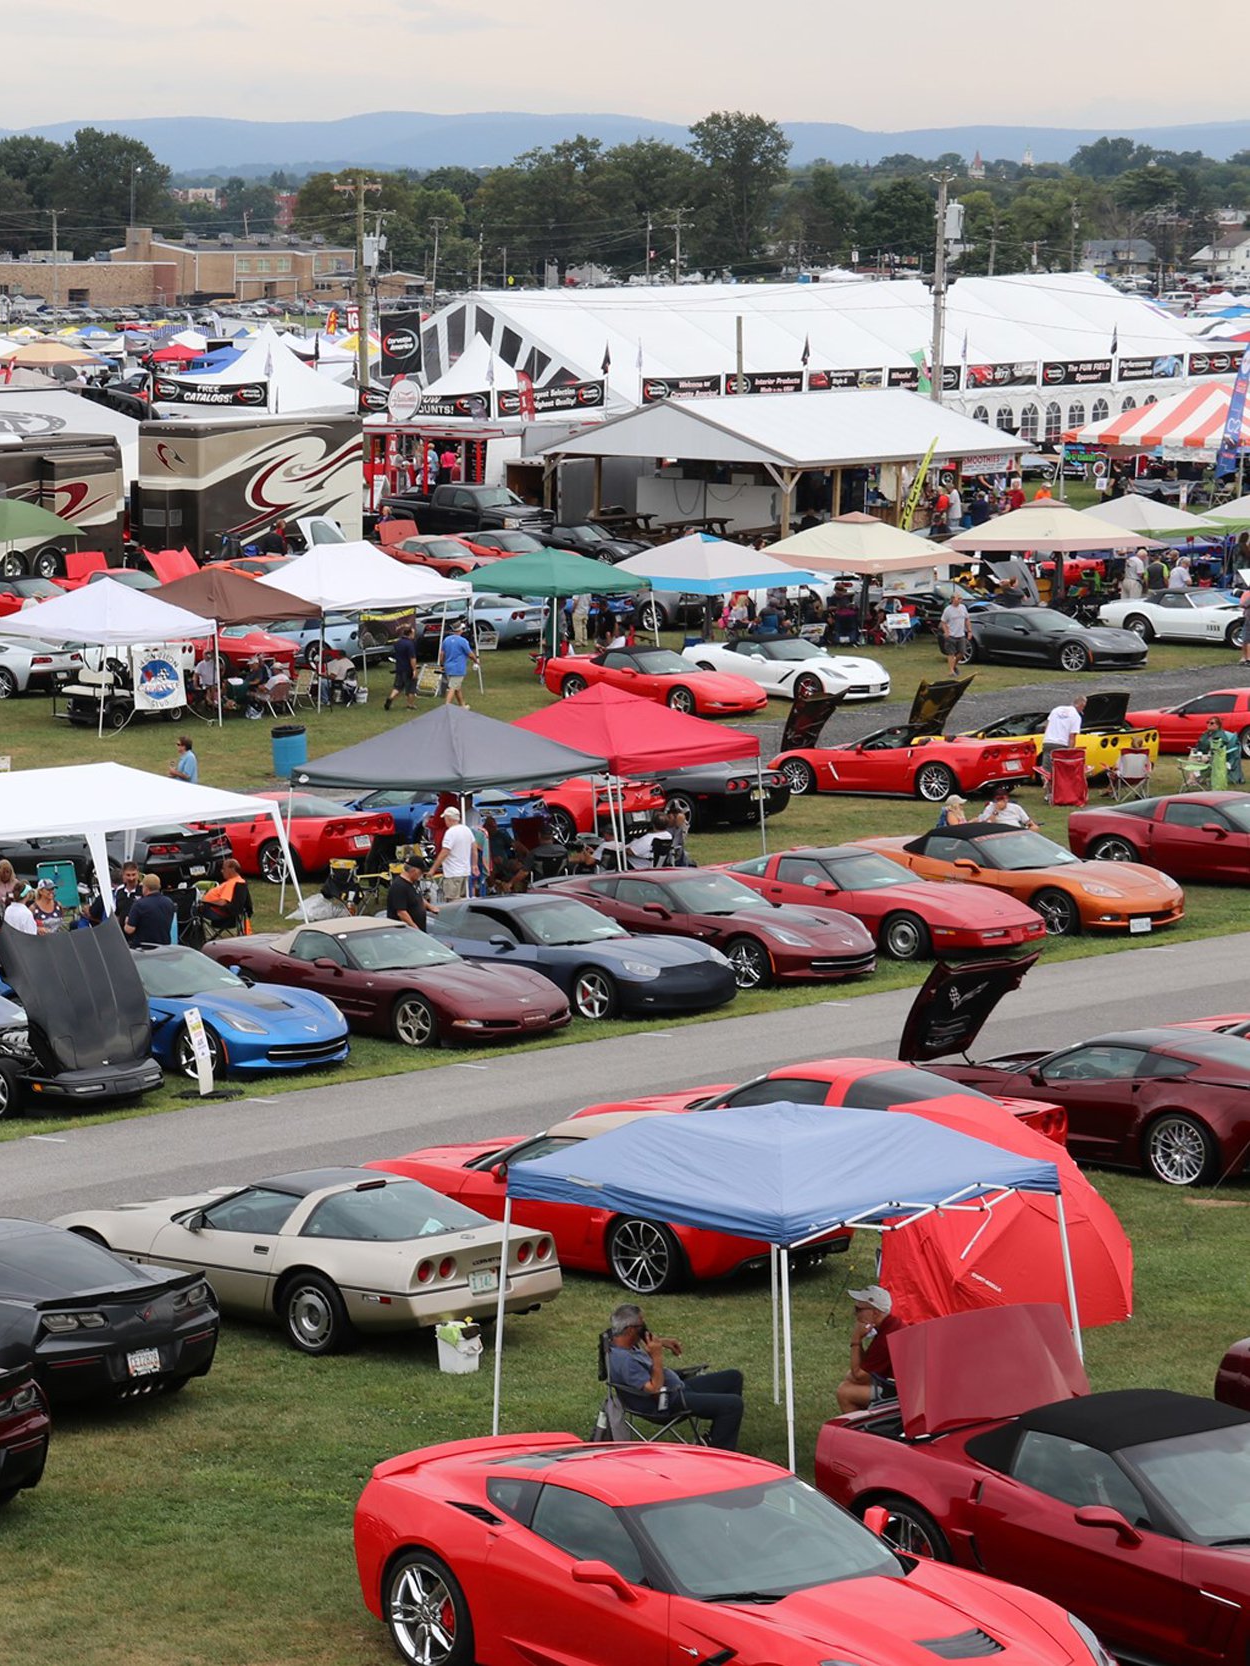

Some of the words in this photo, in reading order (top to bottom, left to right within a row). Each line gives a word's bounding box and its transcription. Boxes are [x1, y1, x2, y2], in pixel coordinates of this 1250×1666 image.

[387, 336, 412, 344] Corvette
[389, 343, 414, 351] America
[1067, 364, 1078, 372] The
[1078, 363, 1092, 372] FUN
[1092, 362, 1111, 371] FIELD
[755, 377, 776, 386] Interior
[776, 376, 801, 385] Products
[1075, 372, 1102, 382] Sponsor!
[196, 385, 221, 393] FREE
[549, 388, 576, 397] Selection
[183, 392, 232, 403] CATALOGS!
[669, 391, 694, 399] Corvette
[534, 398, 555, 409] ighest
[555, 396, 577, 407] Quality!
[962, 453, 1002, 466] SMOOTHIES
